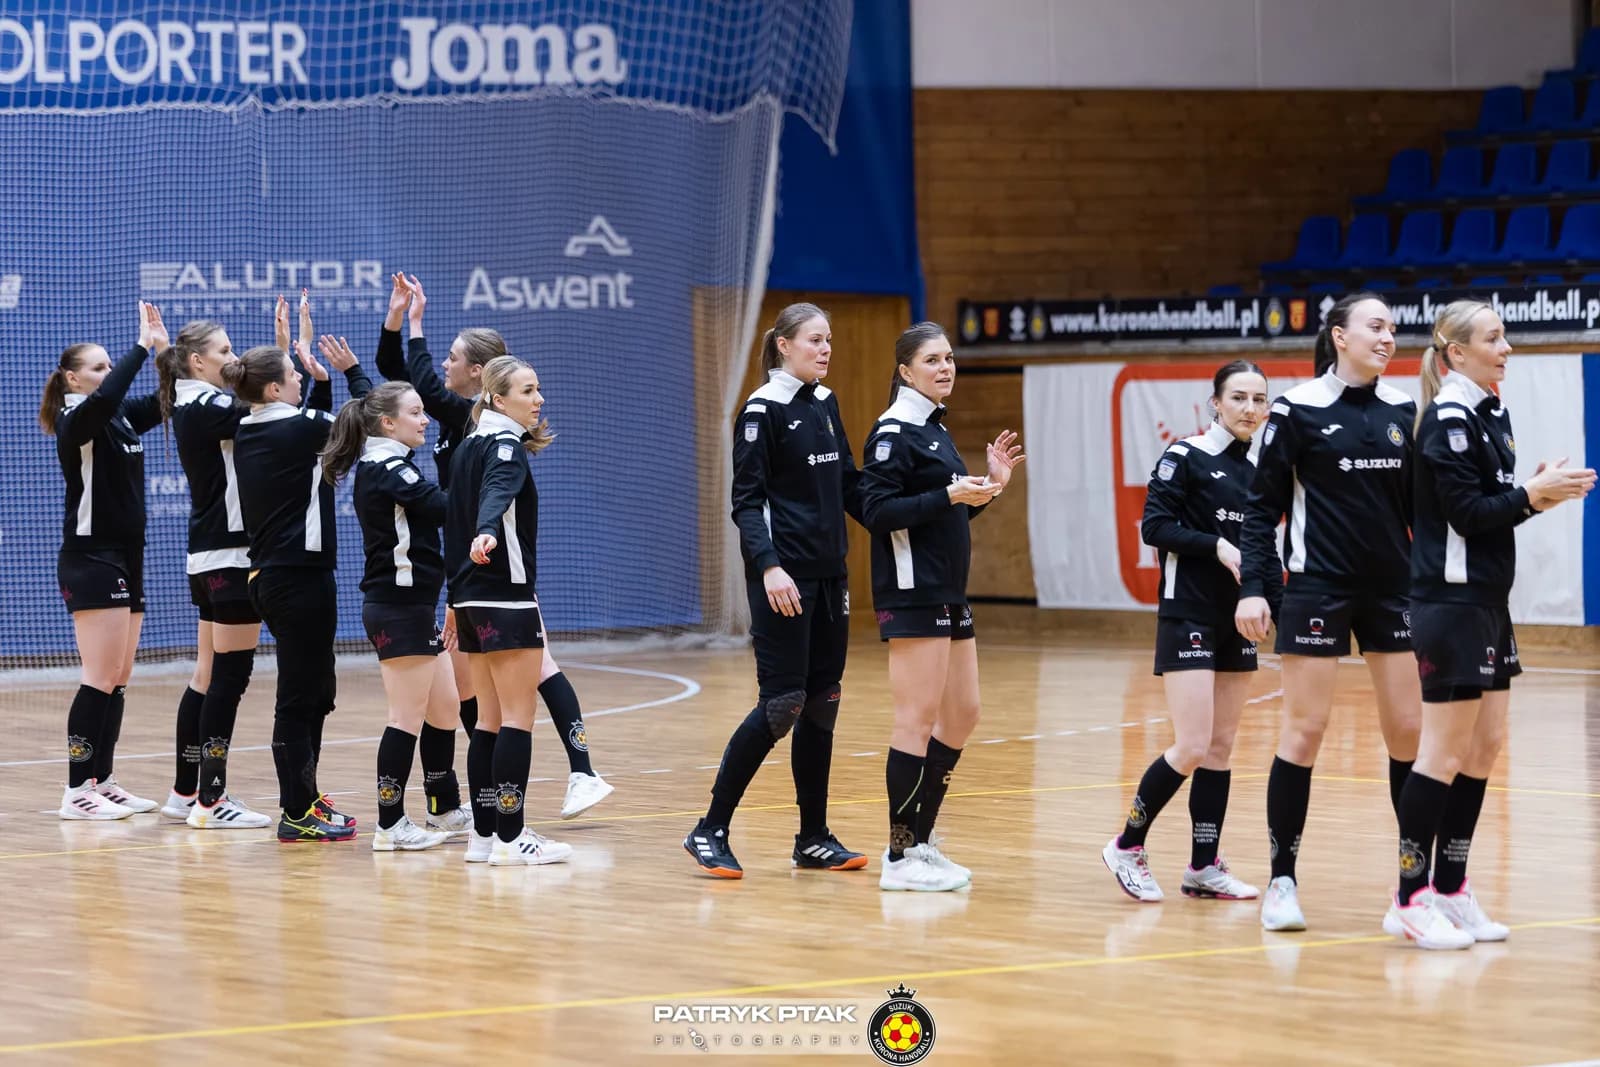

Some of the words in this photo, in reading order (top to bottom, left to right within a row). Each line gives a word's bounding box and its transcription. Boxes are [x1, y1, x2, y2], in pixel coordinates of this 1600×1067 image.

[391, 18, 628, 90] Joma
[177, 261, 383, 289] ALUTOR
[463, 267, 635, 310] Aswent
[1050, 299, 1260, 336] www.koronahandball.pl
[1354, 458, 1402, 469] SUZUKI
